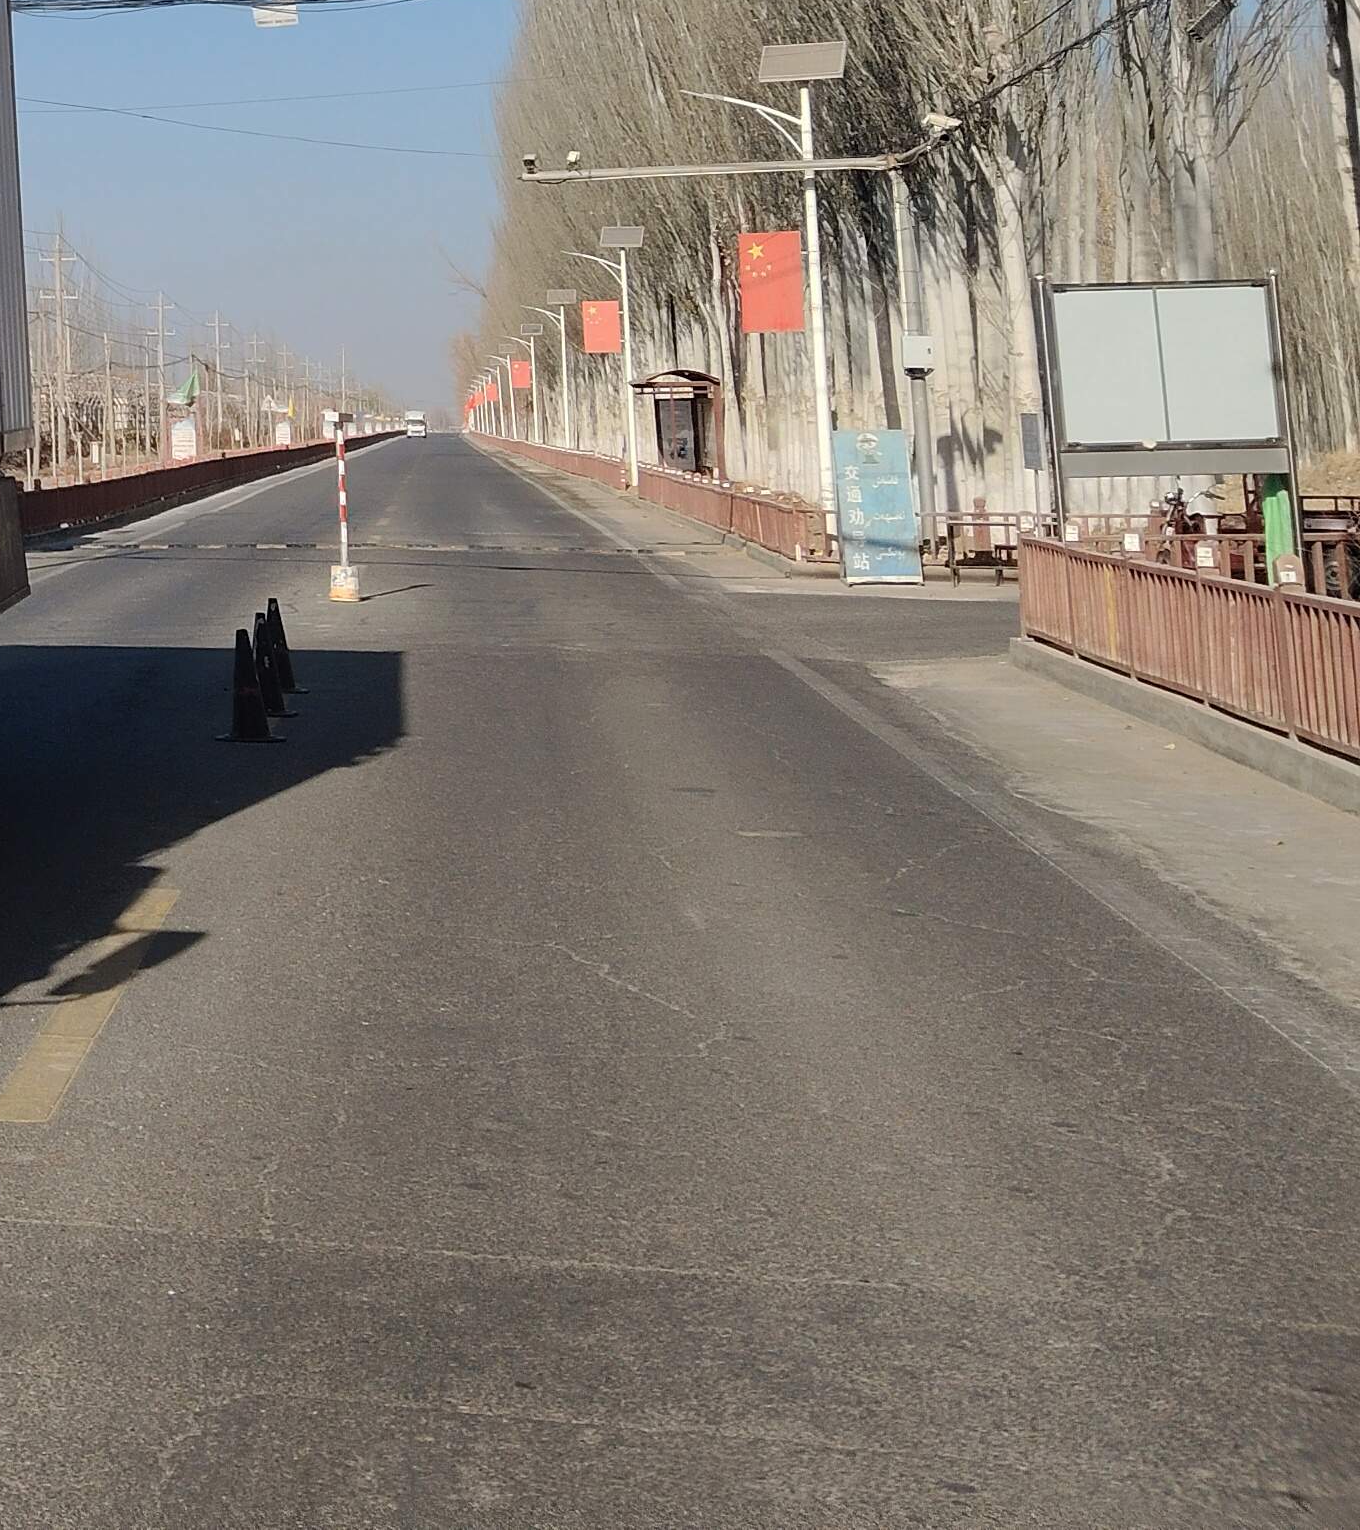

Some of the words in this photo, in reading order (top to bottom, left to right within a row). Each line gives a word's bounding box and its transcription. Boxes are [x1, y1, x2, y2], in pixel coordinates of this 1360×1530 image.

[844, 464, 870, 570] 交通劝导站
